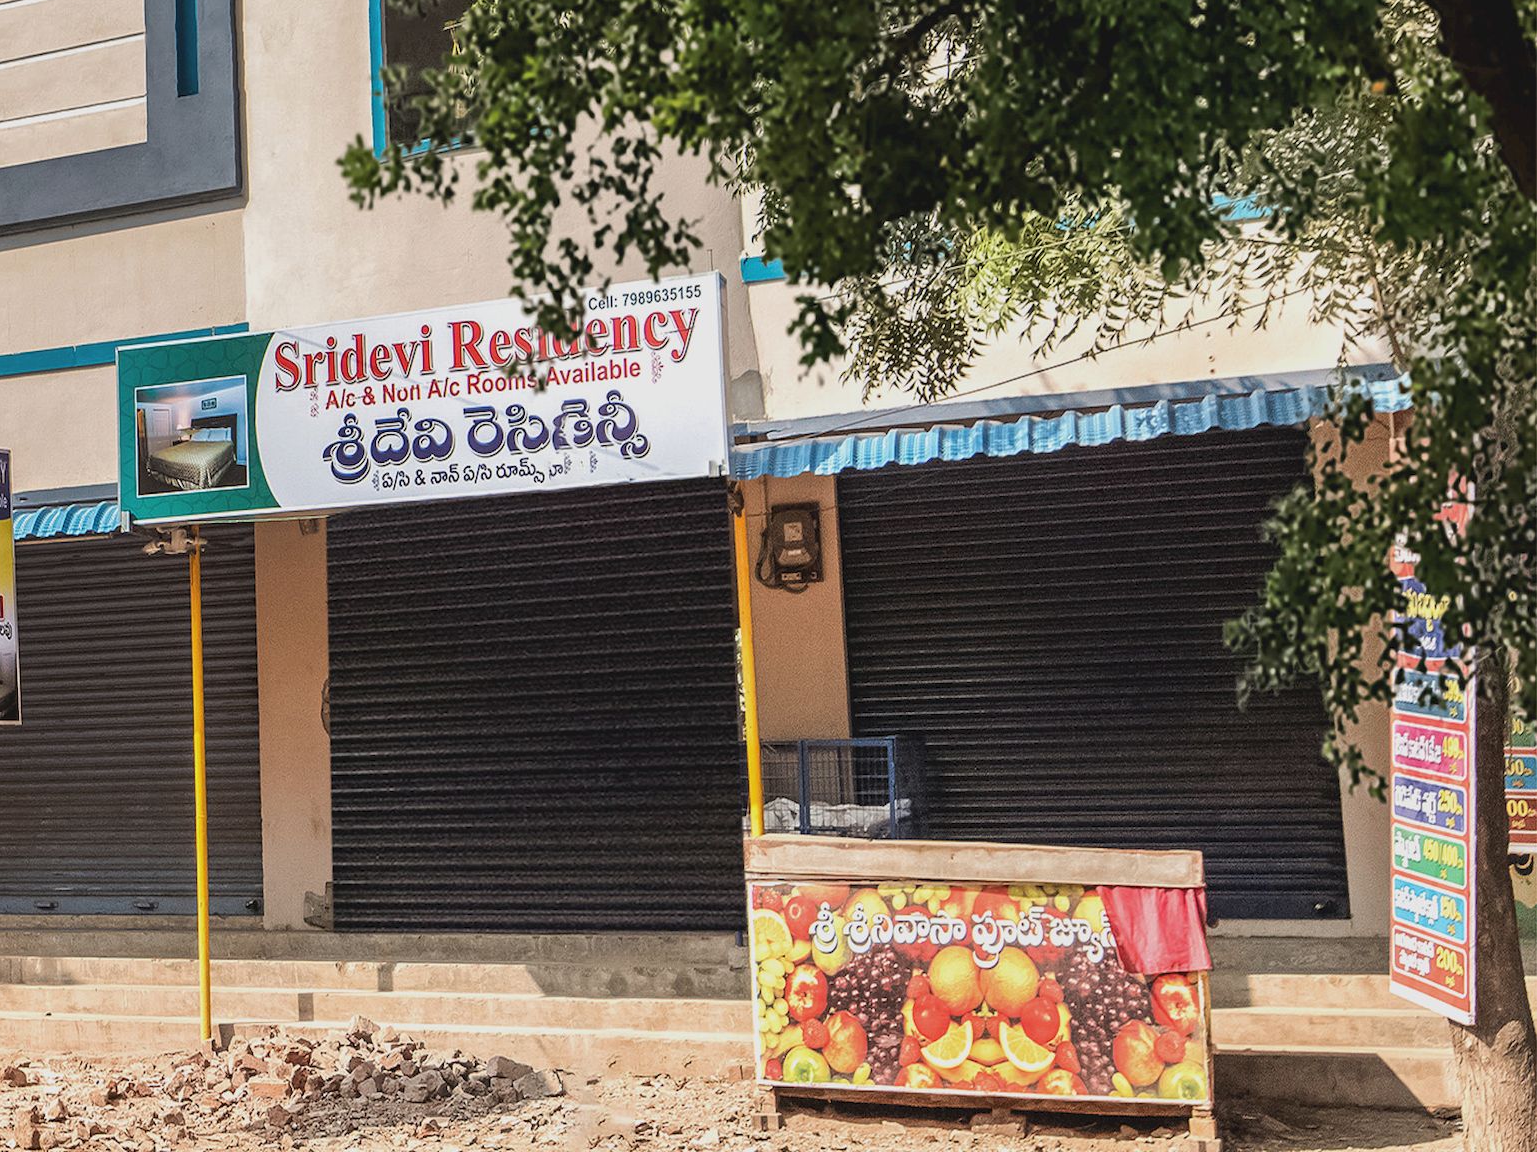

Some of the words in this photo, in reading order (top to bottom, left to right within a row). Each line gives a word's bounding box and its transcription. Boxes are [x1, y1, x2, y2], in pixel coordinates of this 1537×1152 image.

[588, 296, 617, 311] Cell:
[622, 284, 702, 307] 7989635155
[274, 323, 436, 393] Sridevi
[325, 389, 356, 411] A/c
[362, 386, 376, 406] &
[427, 377, 460, 399] A/c
[467, 372, 538, 395] Rooms
[546, 357, 642, 387] Available
[322, 406, 456, 485] శ్రీదేవి
[414, 469, 427, 486] &
[808, 901, 839, 954] శ్రీ
[842, 901, 968, 954] శ్రీనివాసా
